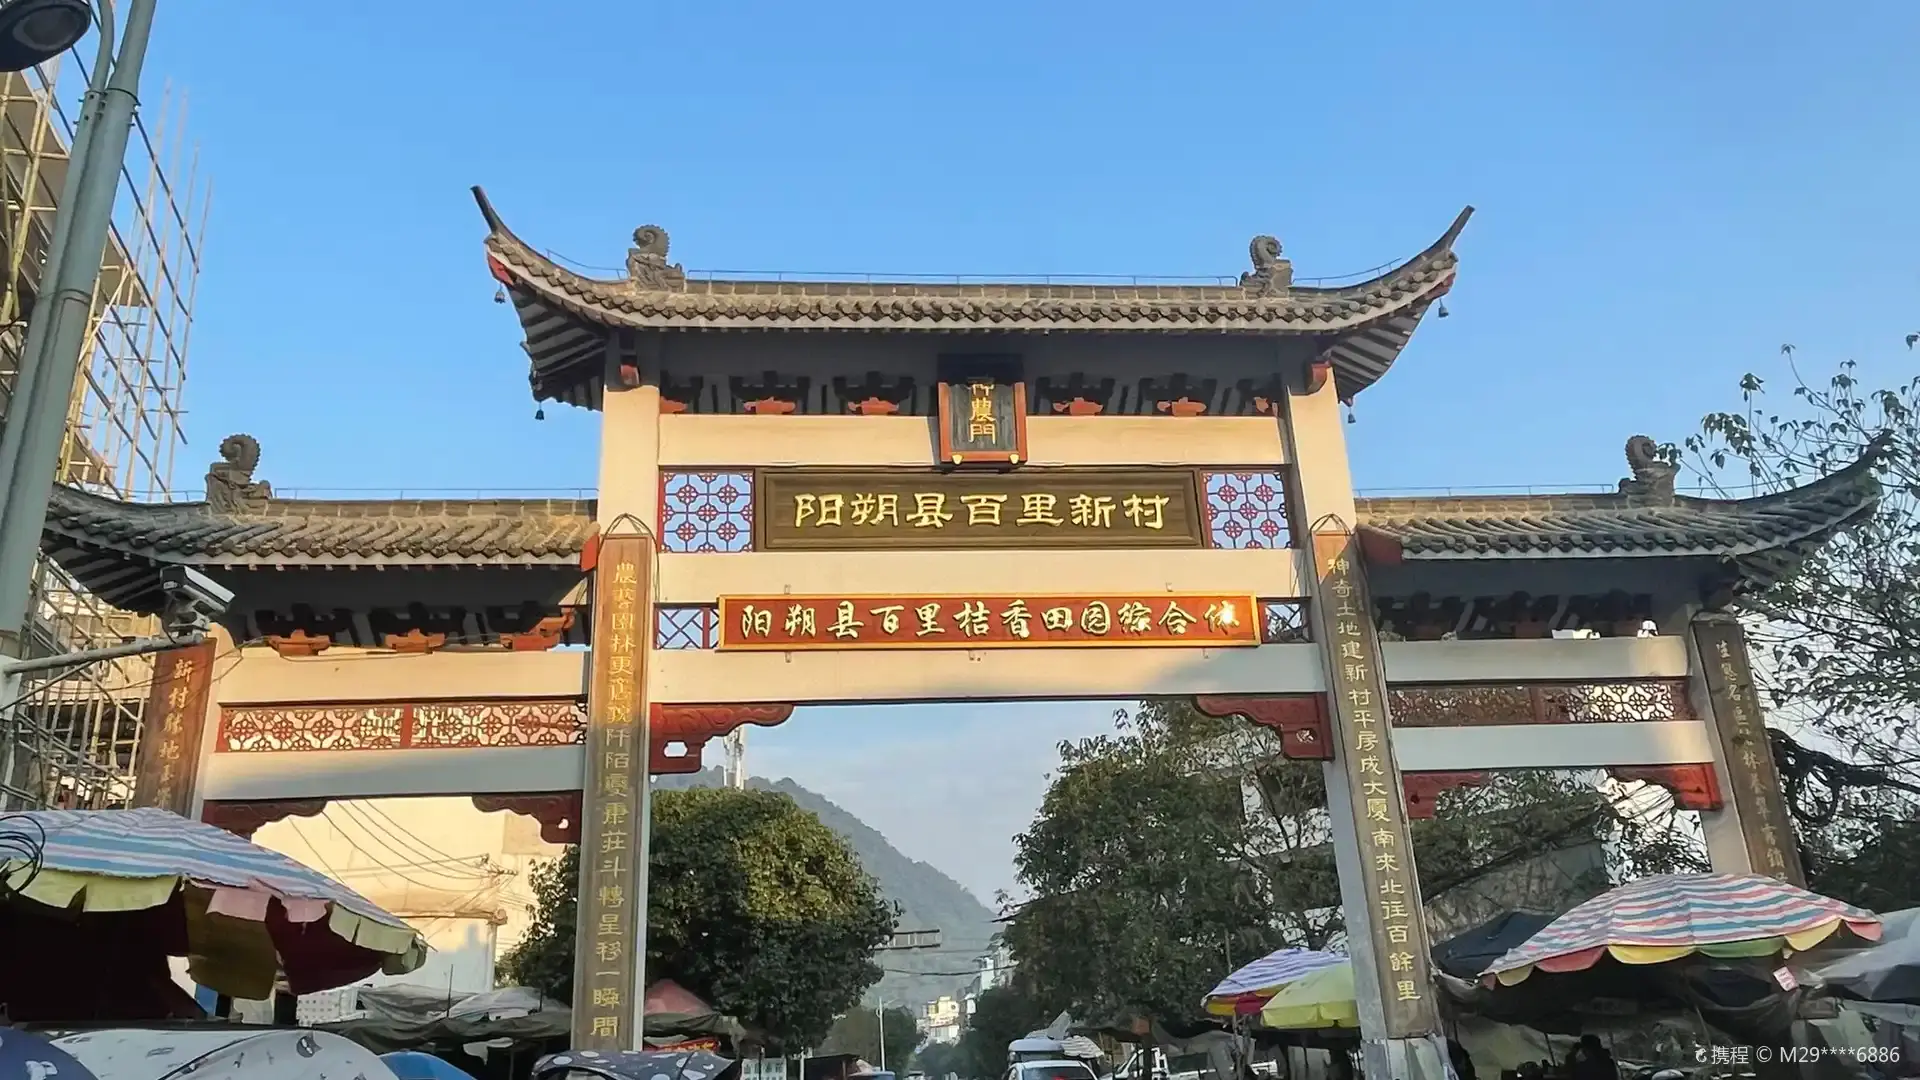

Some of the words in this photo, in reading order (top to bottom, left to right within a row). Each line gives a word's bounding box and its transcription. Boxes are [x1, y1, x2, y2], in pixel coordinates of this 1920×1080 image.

[793, 491, 1170, 530] 阳朔县百里新村
